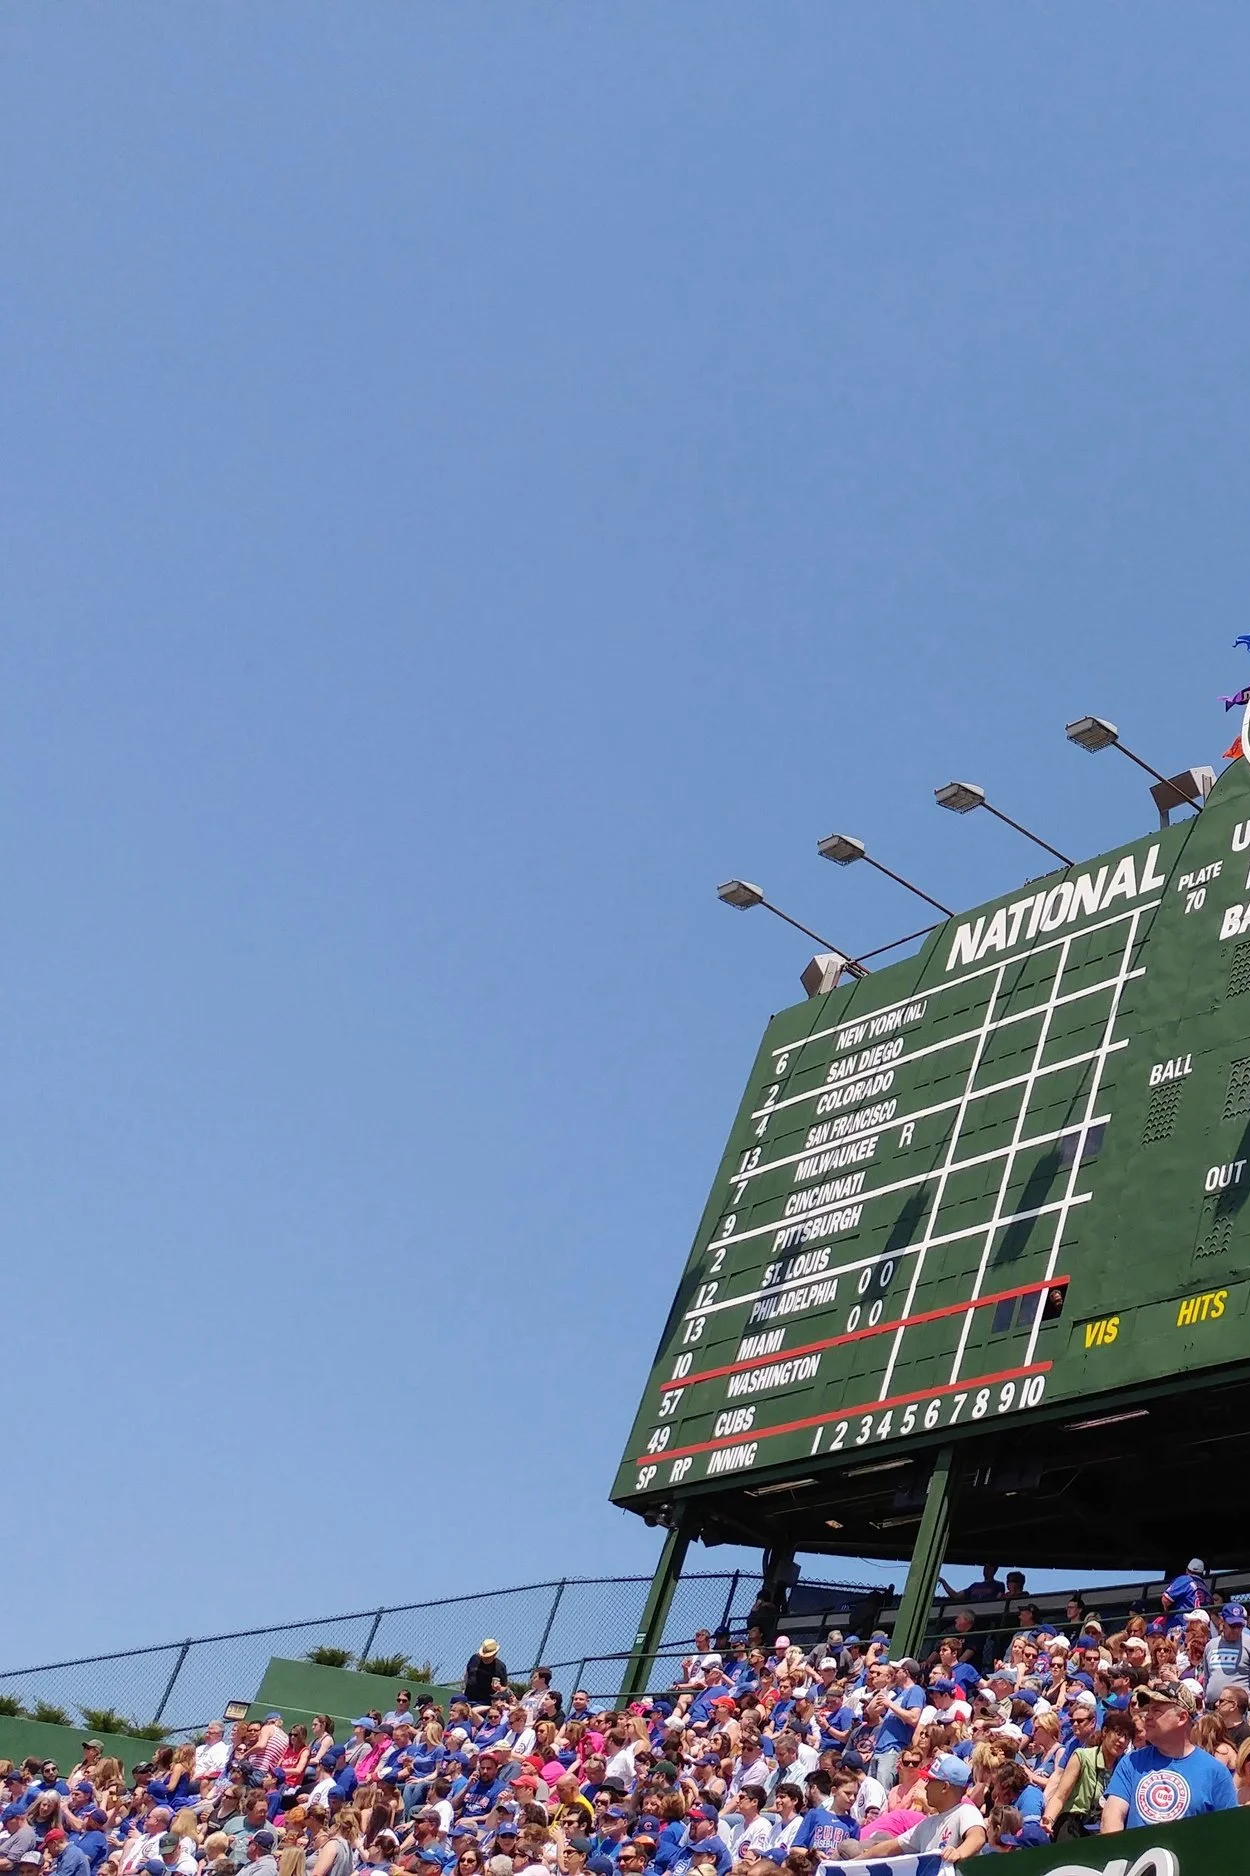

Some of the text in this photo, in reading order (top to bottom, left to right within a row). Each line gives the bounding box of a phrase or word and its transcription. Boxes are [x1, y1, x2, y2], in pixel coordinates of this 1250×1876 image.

[945, 844, 1165, 971] NATIONAL
[1178, 861, 1223, 892] PLATE
[1185, 888, 1206, 914] 70
[763, 1038, 903, 1106] 2 SAN DIEGO
[776, 1053, 789, 1074] 6
[835, 1022, 869, 1051] NEW
[868, 1007, 905, 1039] YORK
[1149, 1054, 1192, 1086] BALL
[740, 1099, 897, 1171] 13 SAN FRANCISCO
[755, 1070, 894, 1137] 4 COLORADO
[733, 1122, 915, 1204] 7 MILWAUKEE R
[1204, 1160, 1247, 1191] OUT
[722, 1171, 865, 1238] 9 CINCINNATI
[710, 1204, 863, 1273] 2 PITTSBURGH
[683, 1261, 893, 1344] 13 PHILADELPHIA 0 0
[696, 1247, 831, 1308] 12 ST. LOUIS
[672, 1300, 882, 1380] 10 MIAMI 0 0
[1084, 1317, 1120, 1348] VIS
[1176, 1291, 1228, 1327] HITS
[659, 1354, 821, 1417] 57 WASHINGTON
[636, 1376, 1045, 1490] SP RP INNING 1 2 3 4 5 6 7 8 9 10
[647, 1406, 755, 1454] 49 CUBS
